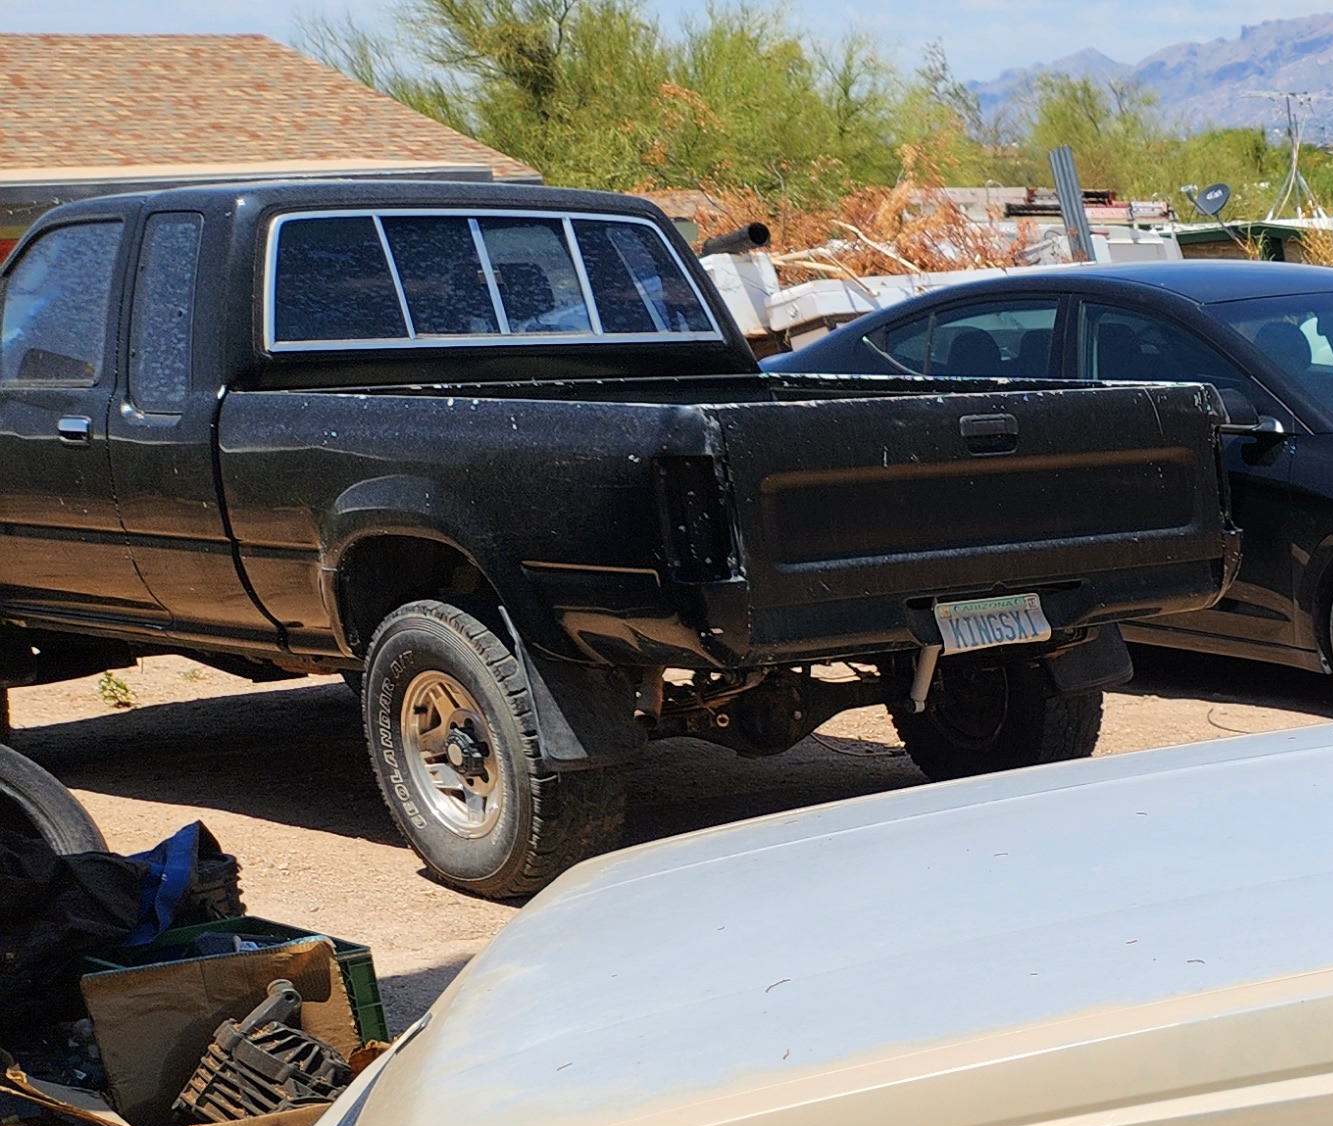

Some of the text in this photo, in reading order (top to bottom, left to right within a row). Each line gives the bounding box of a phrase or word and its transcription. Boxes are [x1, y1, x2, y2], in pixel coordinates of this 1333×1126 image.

[962, 600, 1014, 612] ARIZONA
[378, 649, 428, 831] GEOLANDAR A/T
